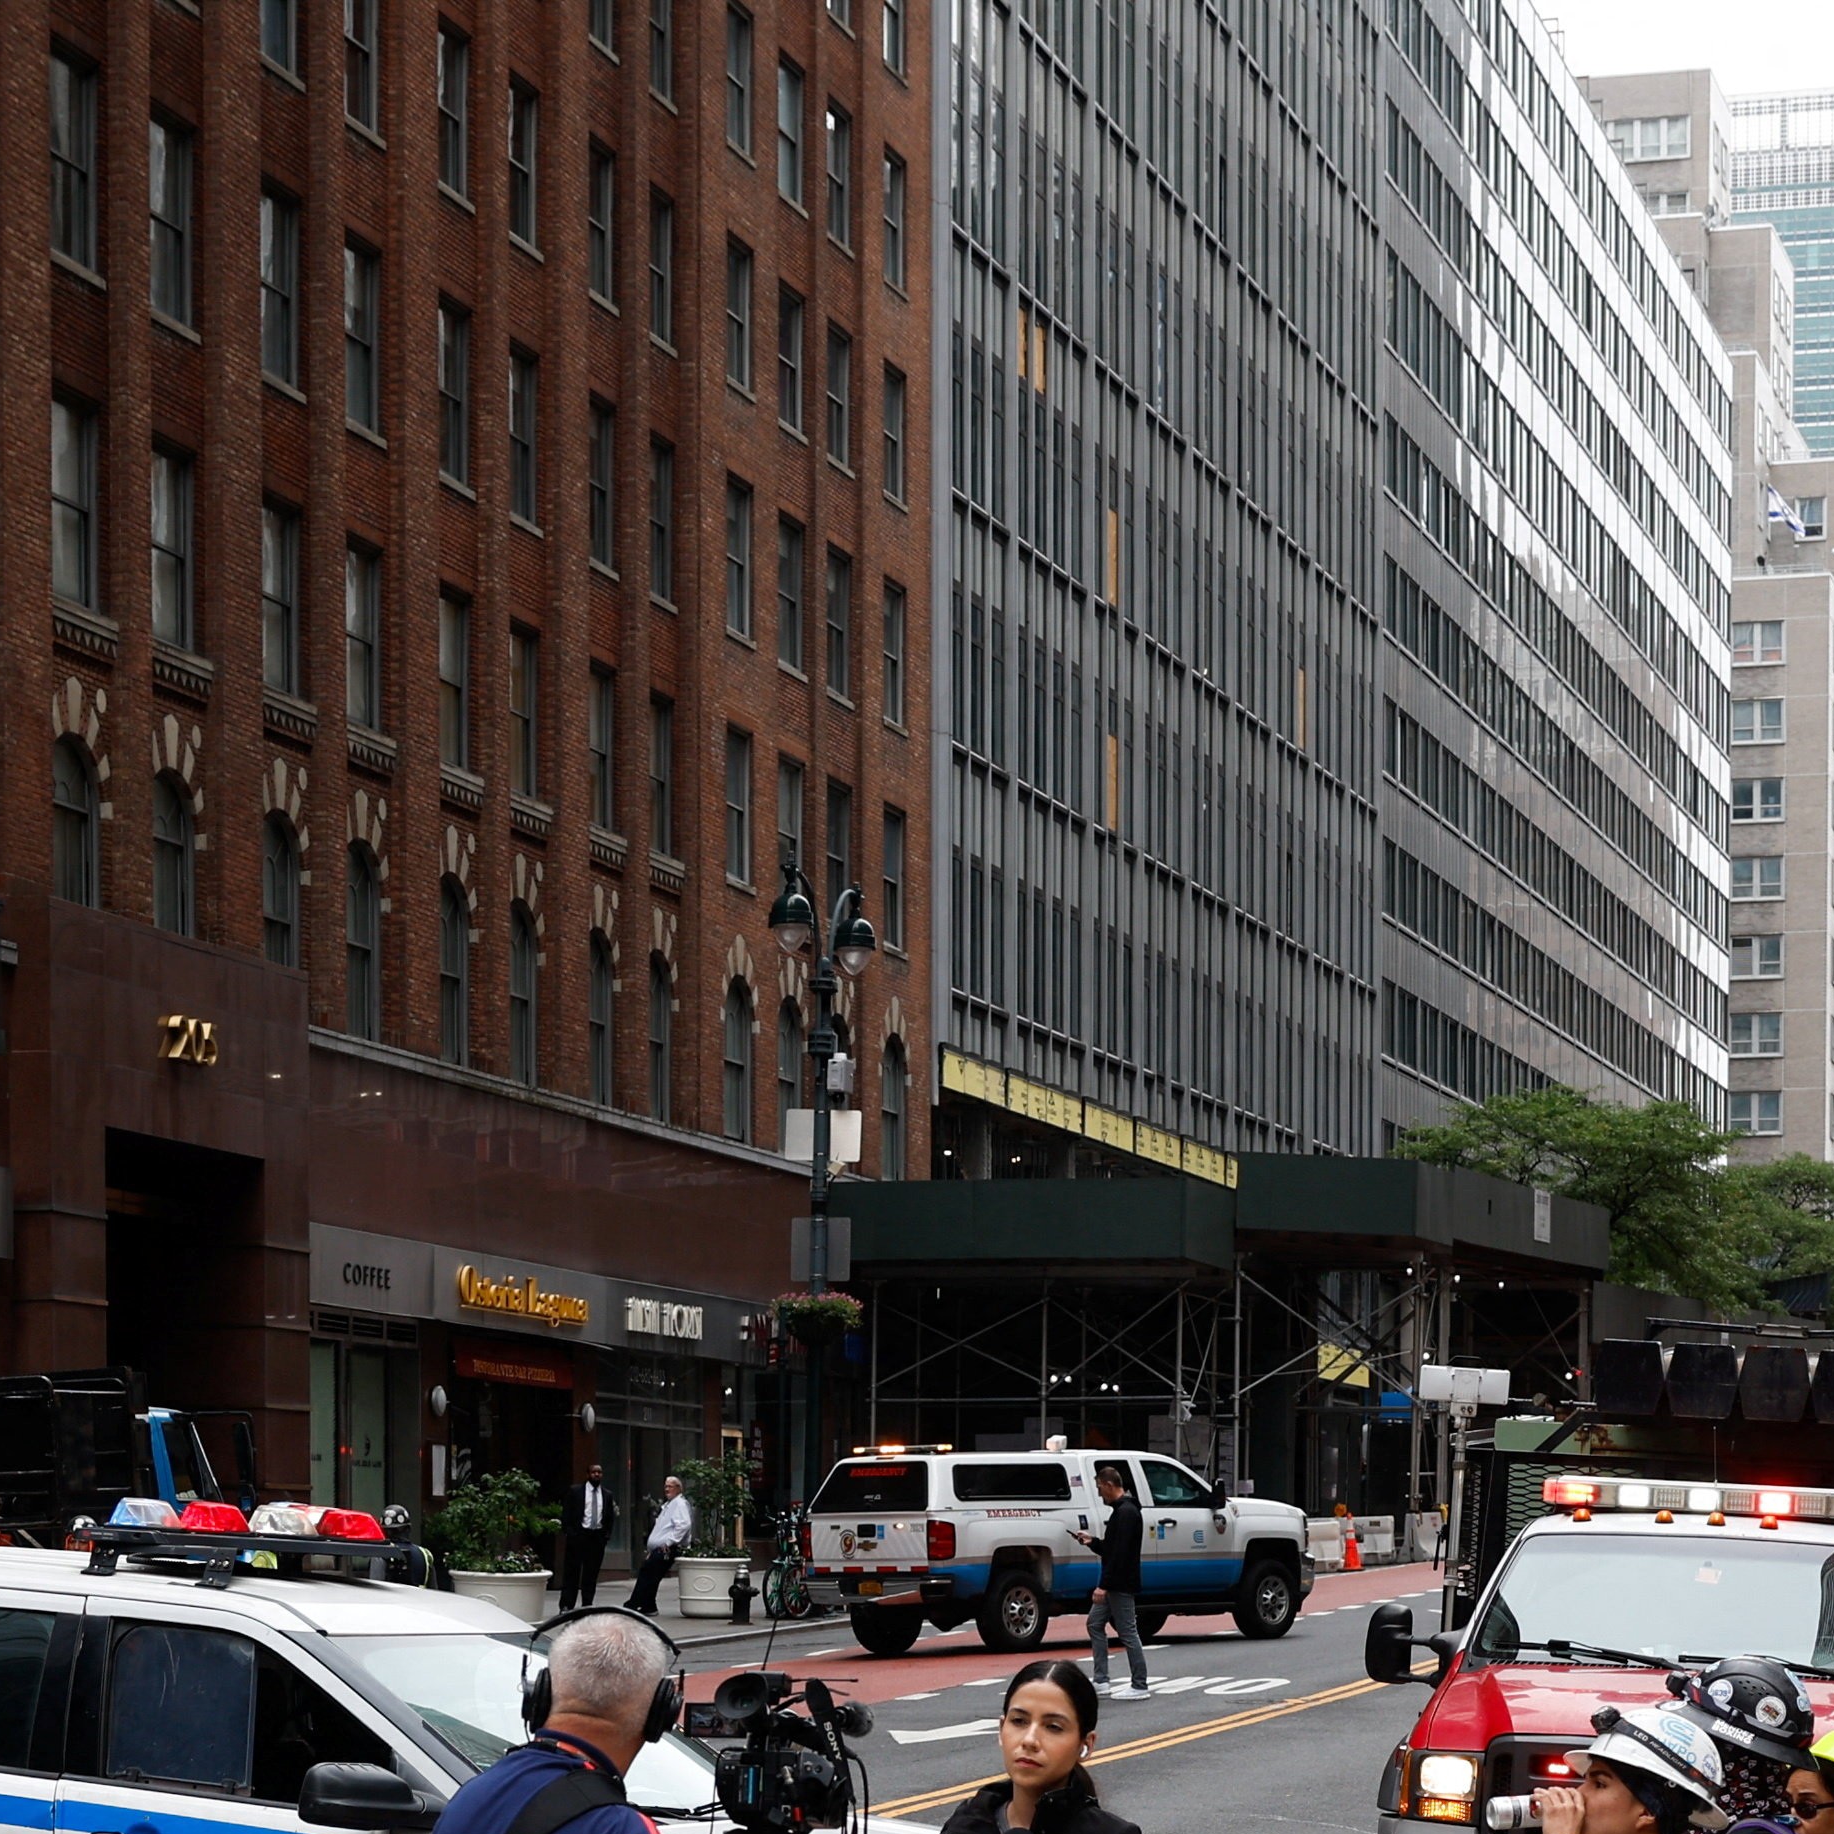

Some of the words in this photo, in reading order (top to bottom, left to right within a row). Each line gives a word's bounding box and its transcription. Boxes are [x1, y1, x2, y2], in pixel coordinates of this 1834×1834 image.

[342, 1262, 392, 1290] COFFEE
[457, 1264, 523, 1312] Osteria
[524, 1276, 589, 1328] Laguna
[986, 1508, 1044, 1518] EMERGENCY
[823, 1721, 843, 1761] SONY
[1633, 1730, 1648, 1743] LED
[1649, 1739, 1687, 1770] HEADLIGHT
[1711, 1724, 1754, 1745] BOXING
